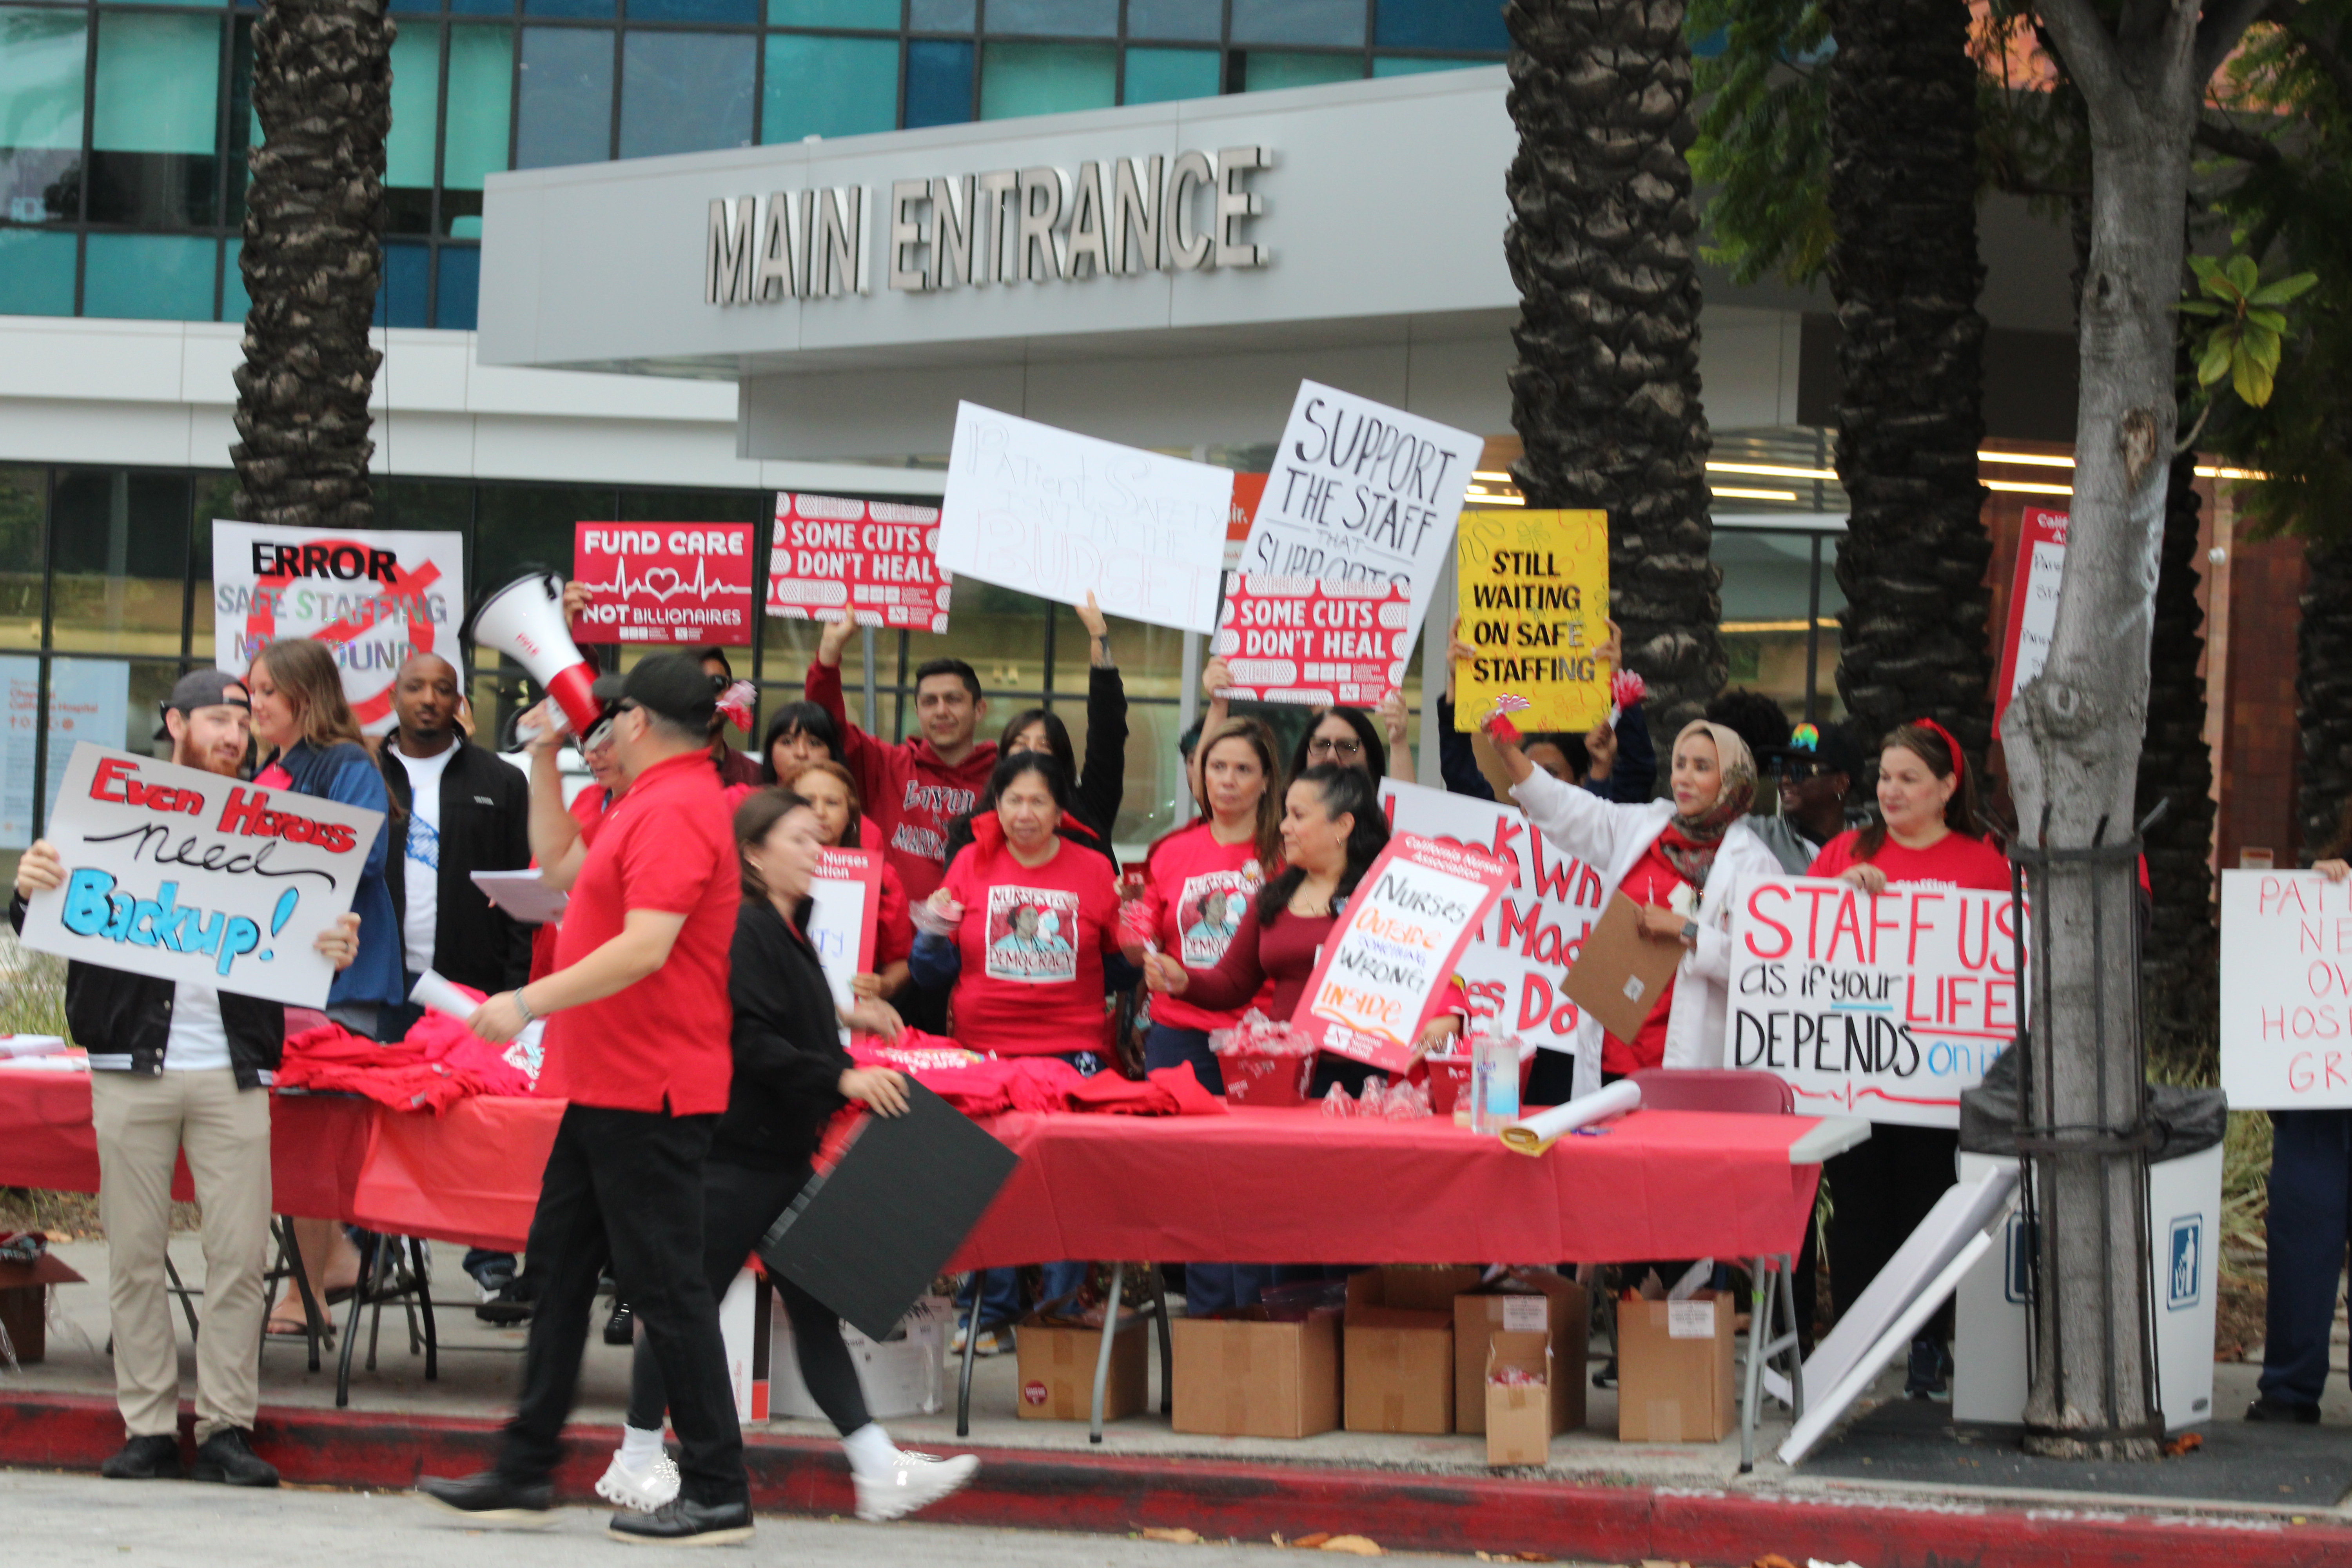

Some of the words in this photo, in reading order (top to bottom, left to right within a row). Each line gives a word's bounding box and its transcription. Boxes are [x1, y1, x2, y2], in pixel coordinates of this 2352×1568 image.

[705, 184, 871, 306] MAIN
[889, 145, 1272, 292] ENTRANCE
[1295, 399, 1457, 506] SUPPORT
[1281, 465, 1343, 528] THE
[1341, 484, 1438, 559] STAFF
[584, 530, 661, 555] FUND
[668, 530, 744, 556] CARE
[791, 521, 856, 549] SOME
[863, 525, 921, 552] CUTS
[1316, 528, 1365, 555] THAT
[252, 541, 397, 584] ERROR
[797, 551, 864, 580] DON'T
[873, 555, 934, 584] HEAL
[974, 508, 1216, 626] BUDGET
[1492, 550, 1561, 577] STILL
[216, 583, 288, 619] SAFE
[296, 588, 448, 626] STAFFING
[583, 603, 631, 624] NOT
[633, 608, 741, 626] BILLIONAIRES
[1240, 599, 1306, 628] SOME
[1313, 601, 1373, 628] CUTS
[1473, 583, 1581, 610] WAITING
[1246, 629, 1314, 657] DON'T
[1323, 630, 1387, 659] HEAL
[1474, 621, 1510, 646] ON
[1516, 621, 1584, 648] SAFE
[324, 638, 419, 671] OUND
[1472, 655, 1595, 684] STAFFING
[88, 756, 205, 816] Even
[217, 787, 358, 854] Heroes
[823, 850, 869, 869] Nurses
[61, 867, 299, 976] Backup!
[1744, 882, 1945, 967] STAFF
[1957, 896, 2031, 976] US
[1339, 944, 1425, 996] WRONG
[1739, 961, 1788, 999] as
[1801, 962, 1826, 999] if
[1829, 971, 1904, 1003] your
[1905, 972, 2017, 1031] LIFE
[2261, 1004, 2352, 1043] HOS
[1735, 1007, 1920, 1078] DEPENDS
[1928, 1039, 1971, 1076] on
